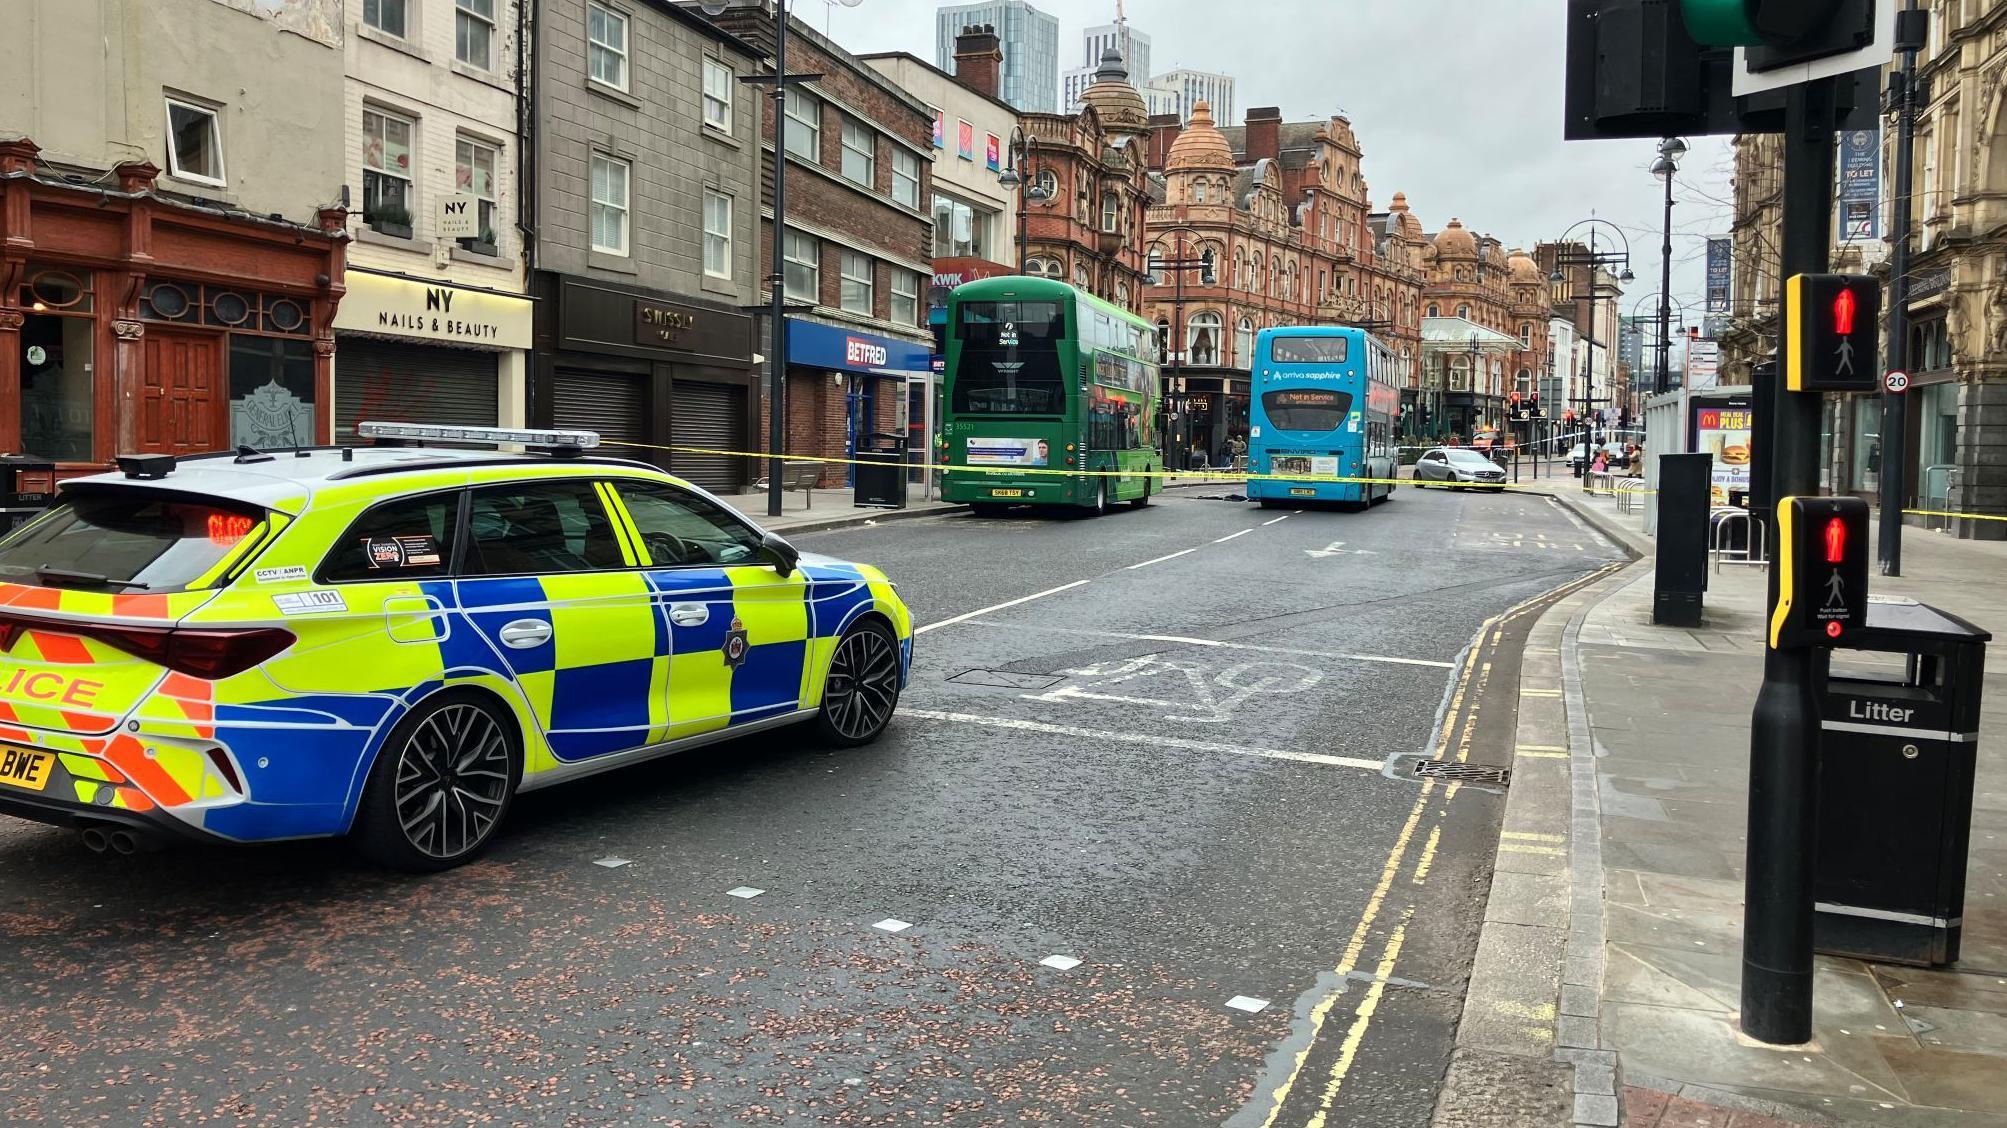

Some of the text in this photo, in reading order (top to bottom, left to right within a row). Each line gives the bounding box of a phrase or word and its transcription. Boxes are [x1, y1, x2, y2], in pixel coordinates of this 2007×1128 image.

[1846, 170, 1858, 178] TO
[445, 201, 467, 214] NY
[932, 272, 963, 286] KWIK
[426, 287, 454, 313] NY
[379, 312, 498, 338] NAILS & BEAUTY
[847, 340, 887, 366] BETFRED
[1282, 371, 1341, 380] arriva sapphire
[1888, 377, 1907, 386] 20
[1311, 393, 1334, 401] Service
[1719, 417, 1744, 430] PLUS
[372, 545, 398, 553] VISION
[374, 551, 400, 562] ZERO
[256, 569, 278, 577] CCTV
[313, 592, 340, 604] 101
[0, 668, 104, 709] ICE
[1849, 700, 1915, 723] Litter
[0, 750, 45, 782] BWE
